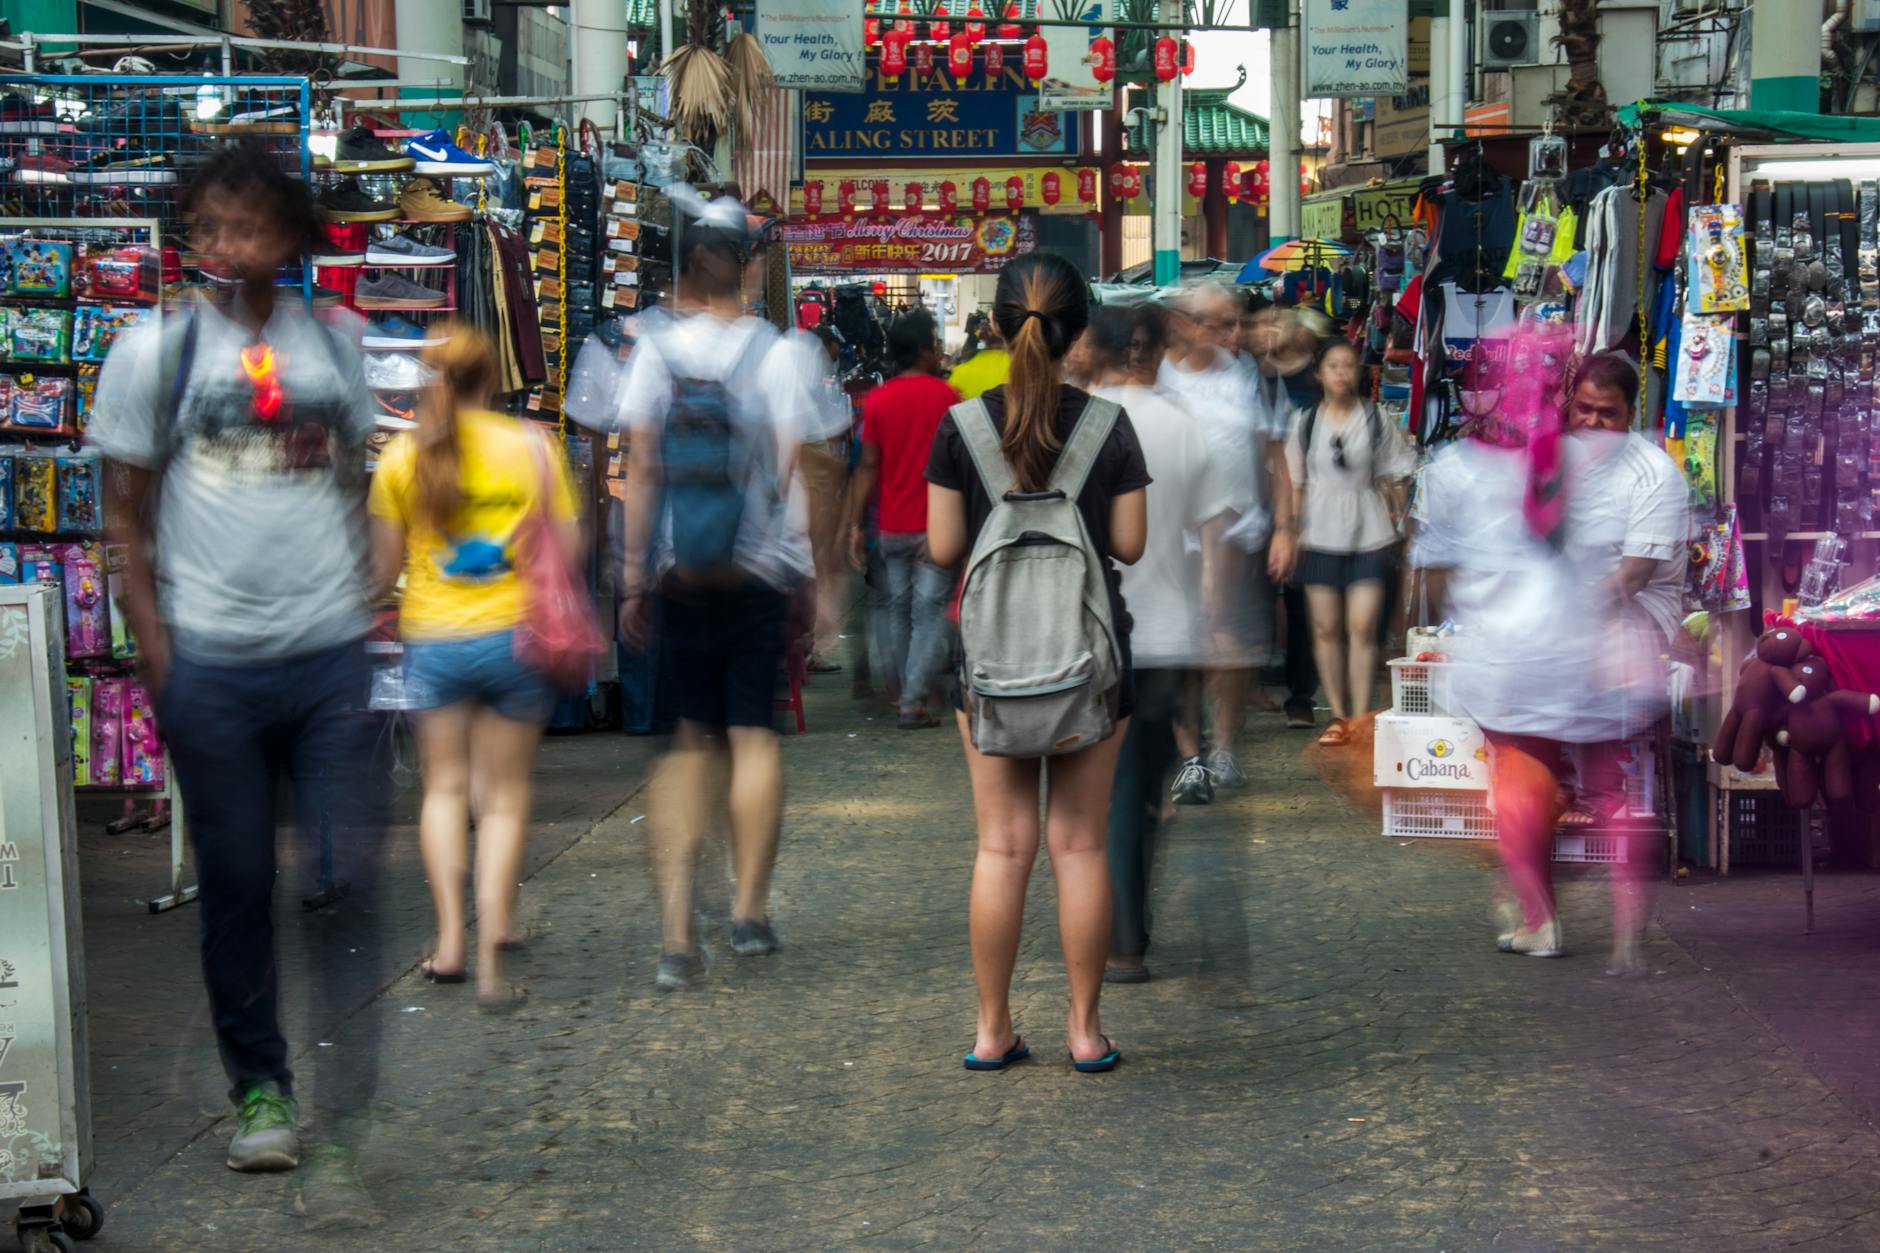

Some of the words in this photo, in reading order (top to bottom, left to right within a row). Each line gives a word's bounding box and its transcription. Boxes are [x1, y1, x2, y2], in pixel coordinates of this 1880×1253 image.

[764, 33, 790, 44] Your
[794, 33, 838, 46] Health,
[799, 49, 817, 62] My
[820, 49, 853, 62] Glory
[1311, 45, 1337, 56] Your
[1340, 43, 1382, 55] Health,
[1345, 59, 1362, 71] My
[1365, 58, 1397, 70] Glory
[900, 128, 999, 149] STREET
[847, 216, 894, 243] Merry
[895, 215, 973, 240] Christmas
[921, 242, 973, 261] 2017
[1406, 757, 1471, 780] Cabana
